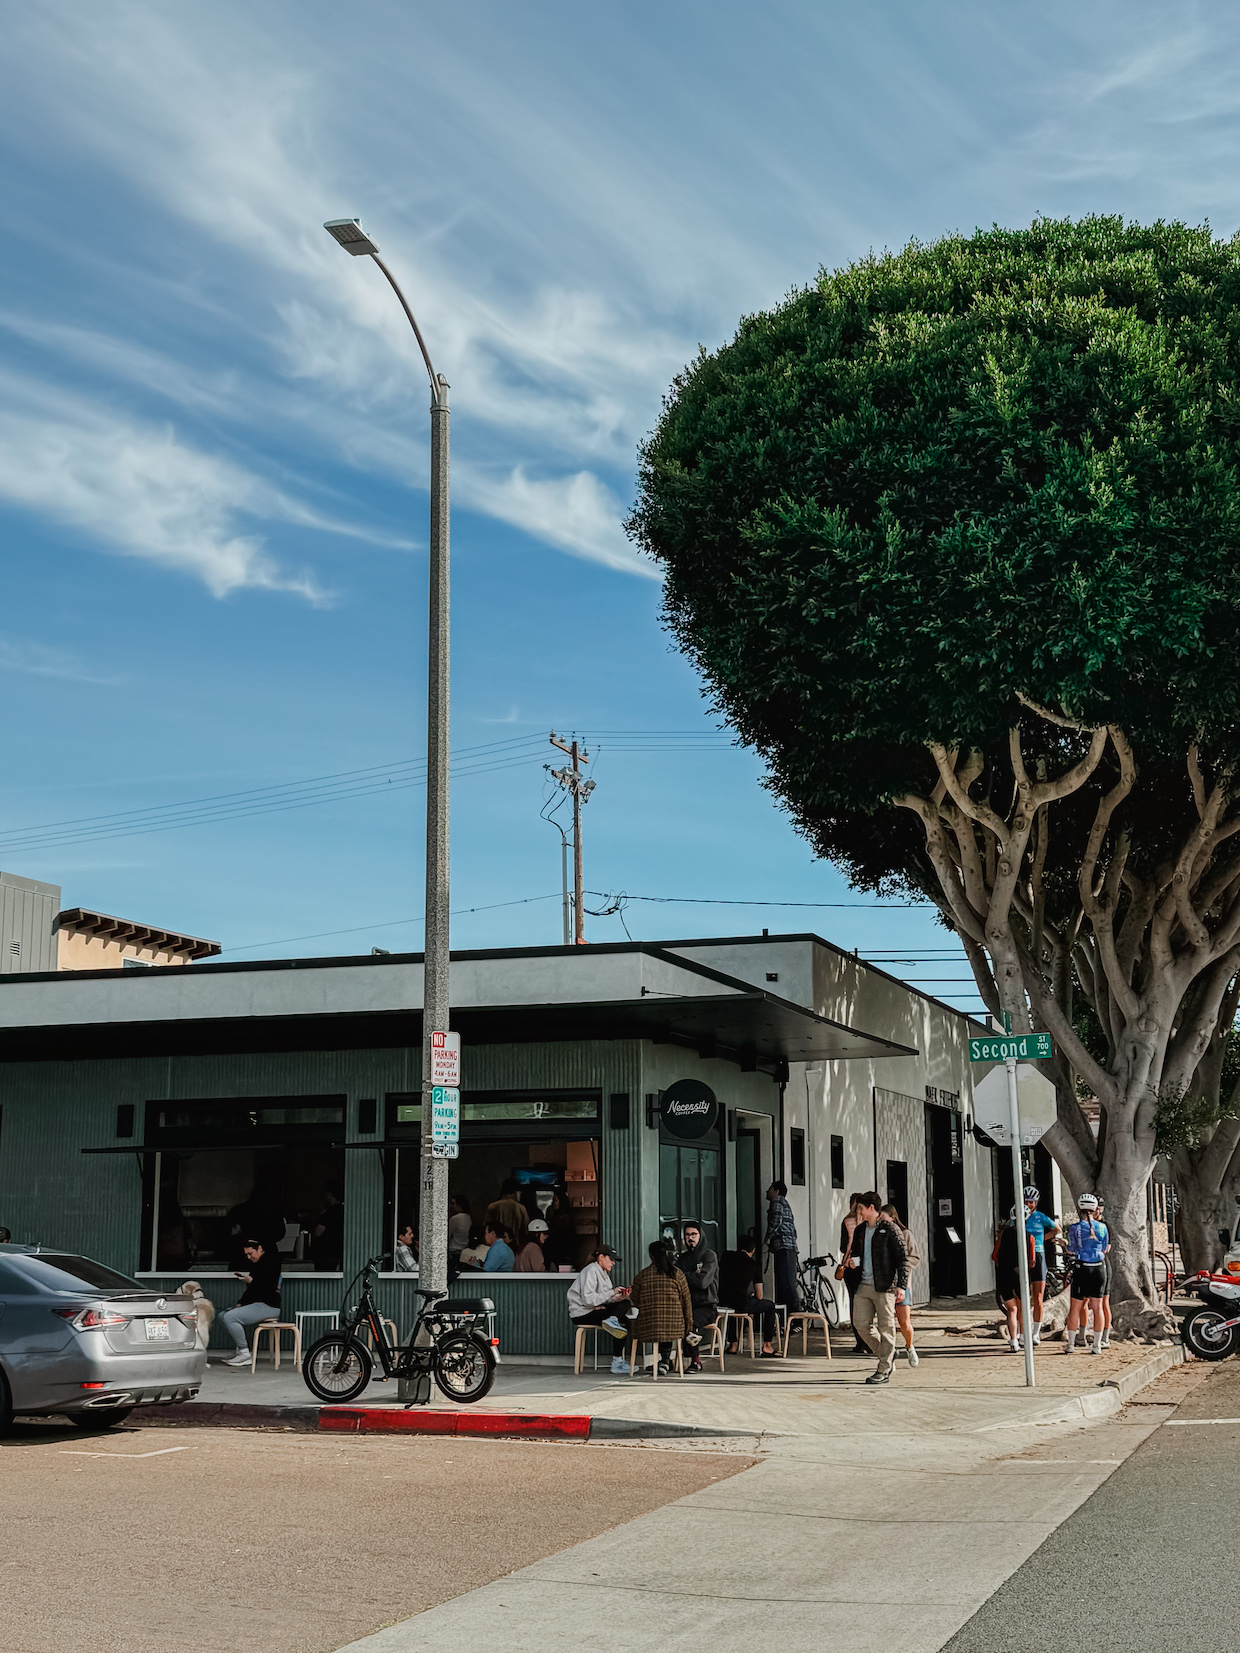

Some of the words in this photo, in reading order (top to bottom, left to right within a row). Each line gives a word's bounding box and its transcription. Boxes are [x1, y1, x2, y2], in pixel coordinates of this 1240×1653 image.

[434, 1033, 443, 1046] NO
[434, 1050, 457, 1060] PARKING
[971, 1039, 1028, 1059] Second
[435, 1090, 442, 1102] 2
[443, 1093, 457, 1102] HOUR
[434, 1108, 457, 1118] PARKING
[667, 1100, 710, 1114] Necessity
